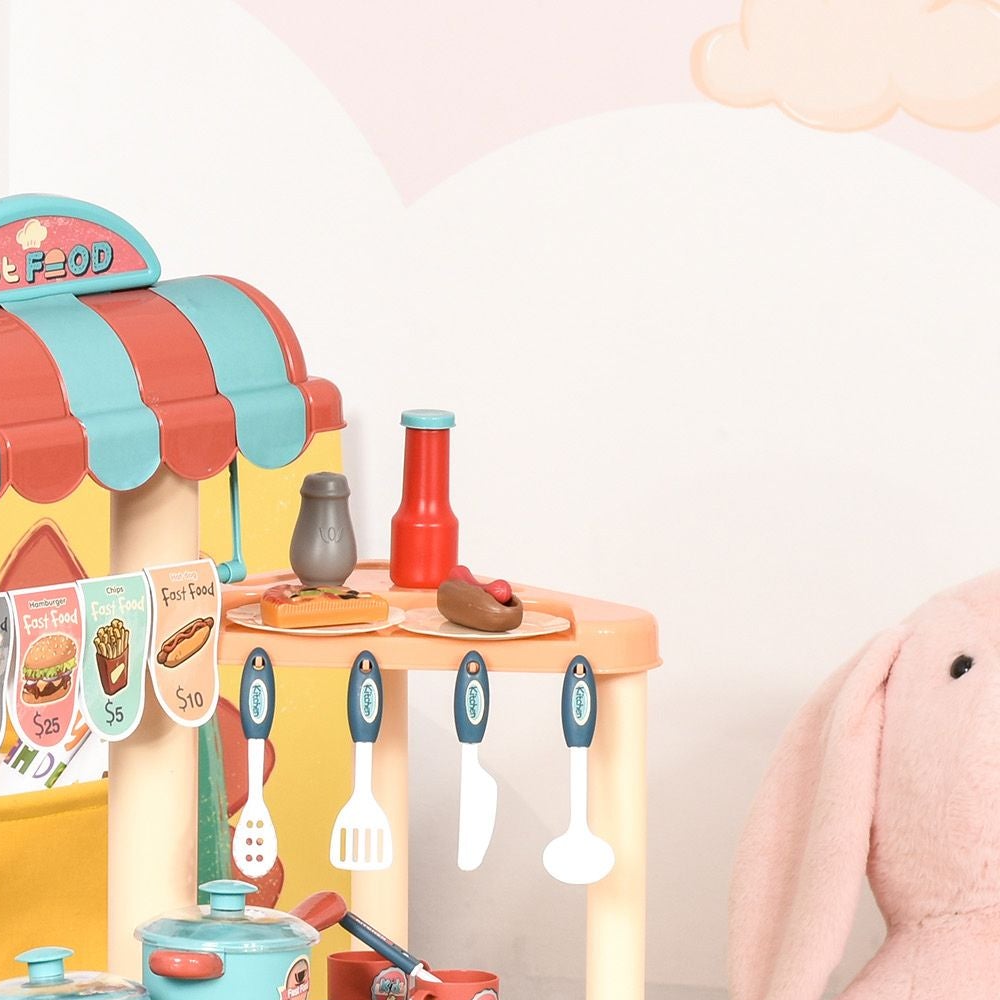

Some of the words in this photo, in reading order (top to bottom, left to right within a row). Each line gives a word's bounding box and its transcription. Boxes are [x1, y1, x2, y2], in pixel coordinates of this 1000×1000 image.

[29, 597, 67, 609] Hamburger
[106, 586, 124, 596] Chips
[161, 586, 187, 607] Fast
[188, 582, 215, 600] Food
[90, 602, 116, 621] Fast
[117, 596, 145, 614] Food
[22, 613, 50, 635] Fast
[51, 610, 78, 628] Food
[176, 685, 204, 712] $10
[252, 684, 262, 718] Kitchen
[363, 684, 373, 718] Kitchen
[468, 686, 478, 719] Kitchen
[575, 686, 585, 719] Kitchen
[33, 711, 60, 738] $25
[104, 699, 124, 726] $5
